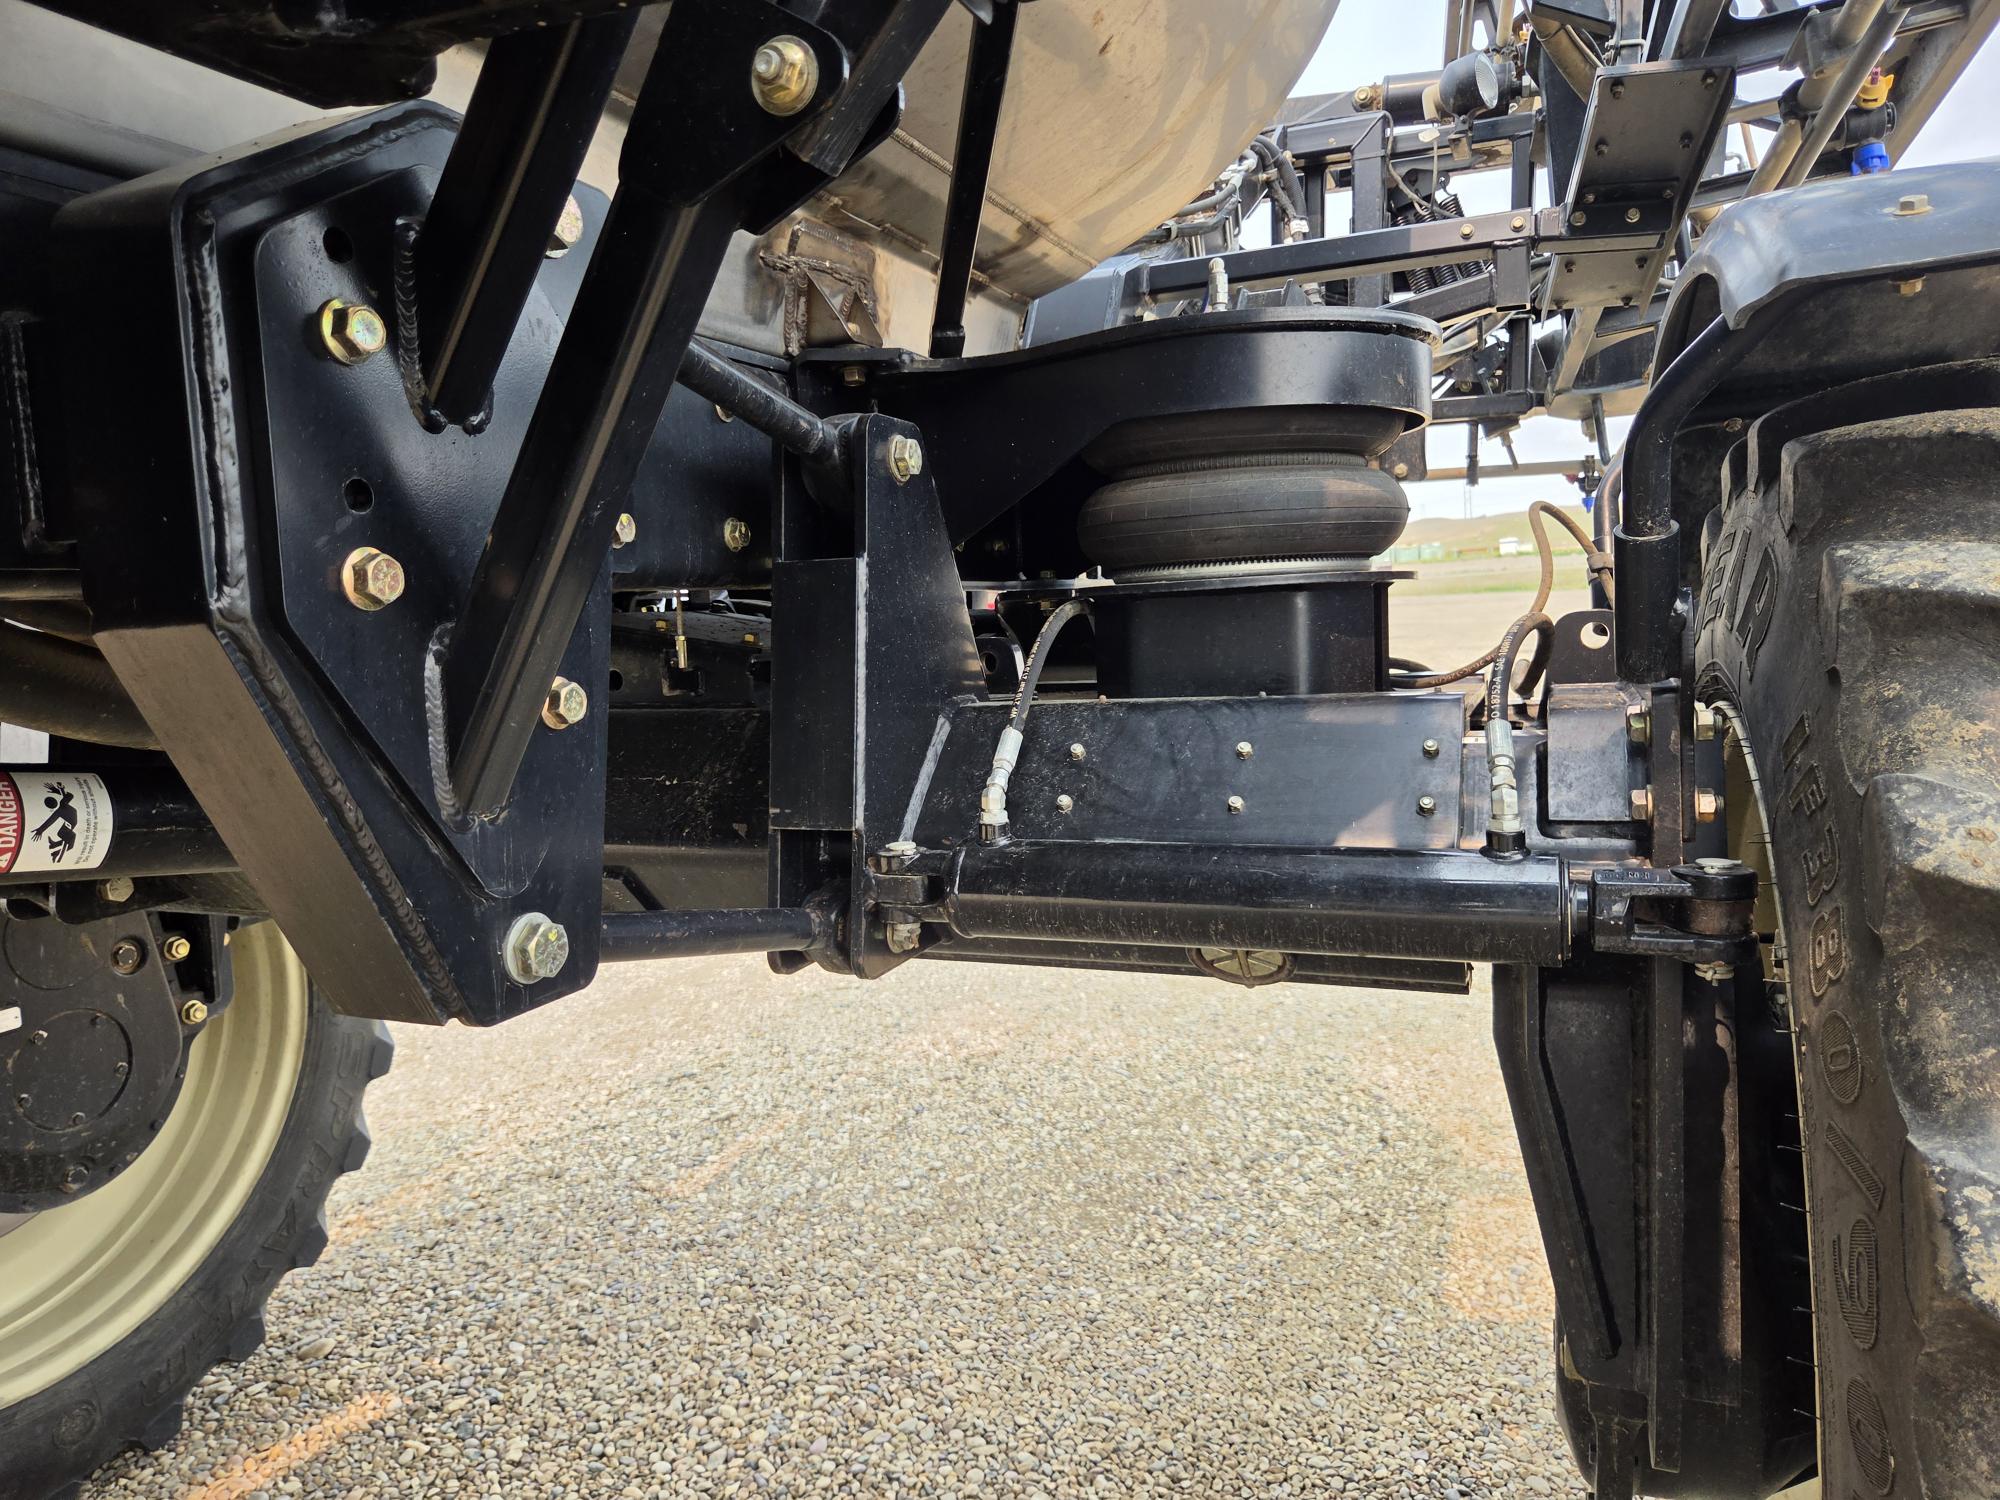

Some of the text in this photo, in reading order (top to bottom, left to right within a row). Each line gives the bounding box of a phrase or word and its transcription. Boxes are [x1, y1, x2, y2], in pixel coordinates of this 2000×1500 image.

[1495, 657, 1506, 673] SAE
[1491, 675, 1502, 710] 18752-A
[1781, 710, 1895, 1500] IF380/90
